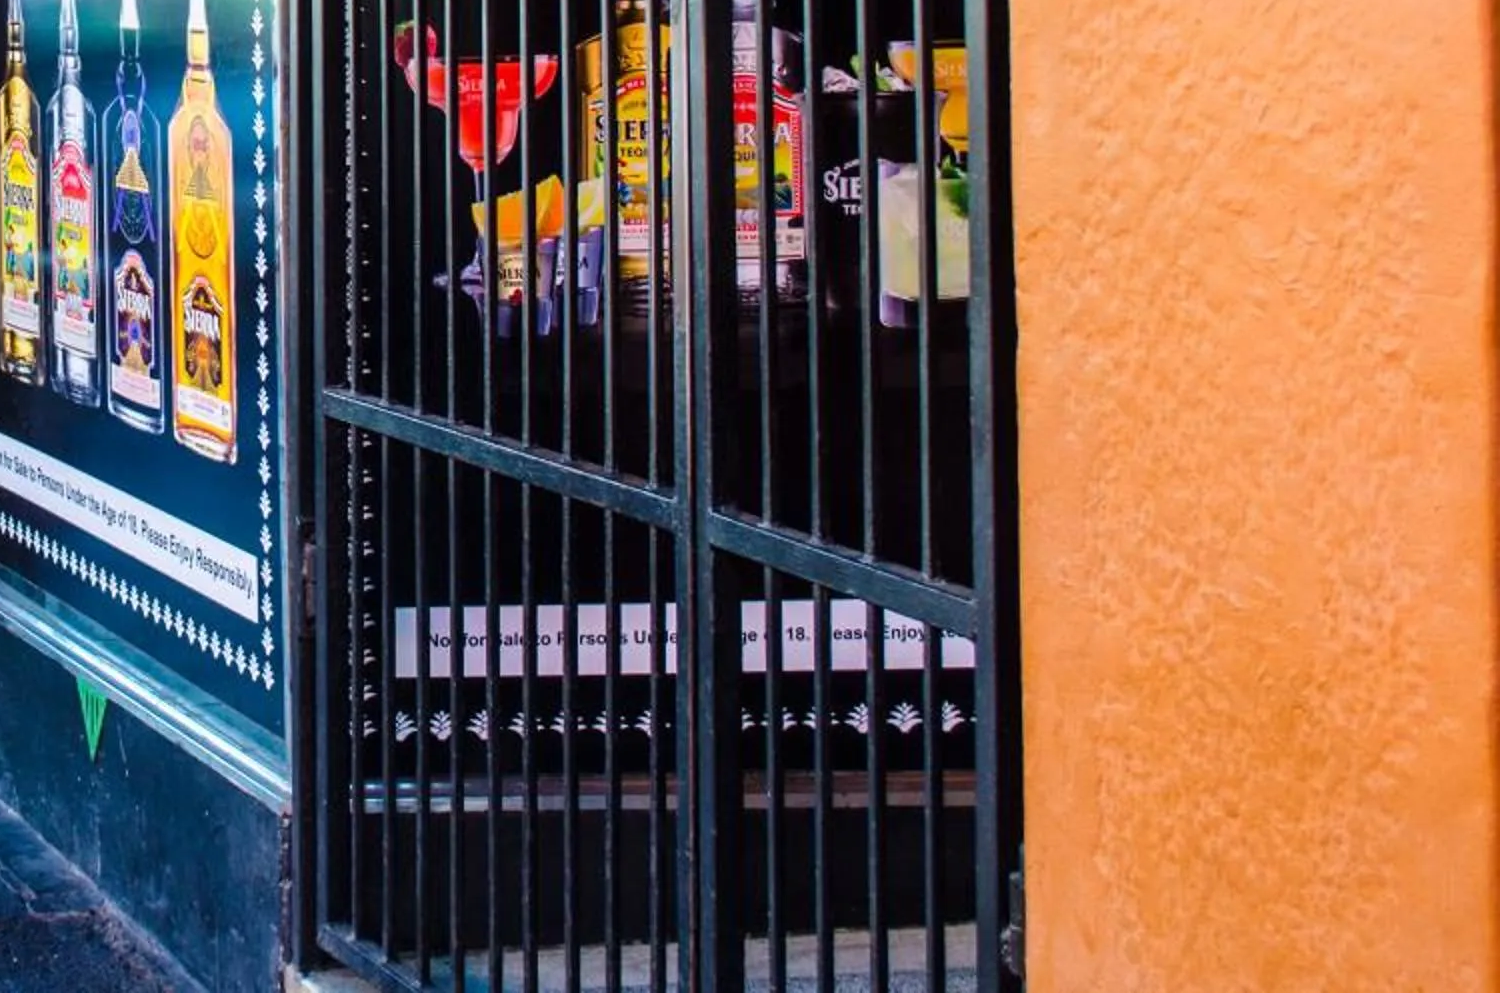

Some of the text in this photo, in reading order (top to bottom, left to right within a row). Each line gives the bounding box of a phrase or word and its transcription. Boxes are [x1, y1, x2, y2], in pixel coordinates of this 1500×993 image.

[66, 483, 87, 508] Under
[88, 495, 101, 515] the
[102, 501, 117, 527] Age
[118, 510, 127, 528] of
[141, 519, 168, 550] Please
[169, 534, 195, 569] Enjoy
[196, 548, 255, 600] Responsibly.
[786, 625, 811, 642] 18.
